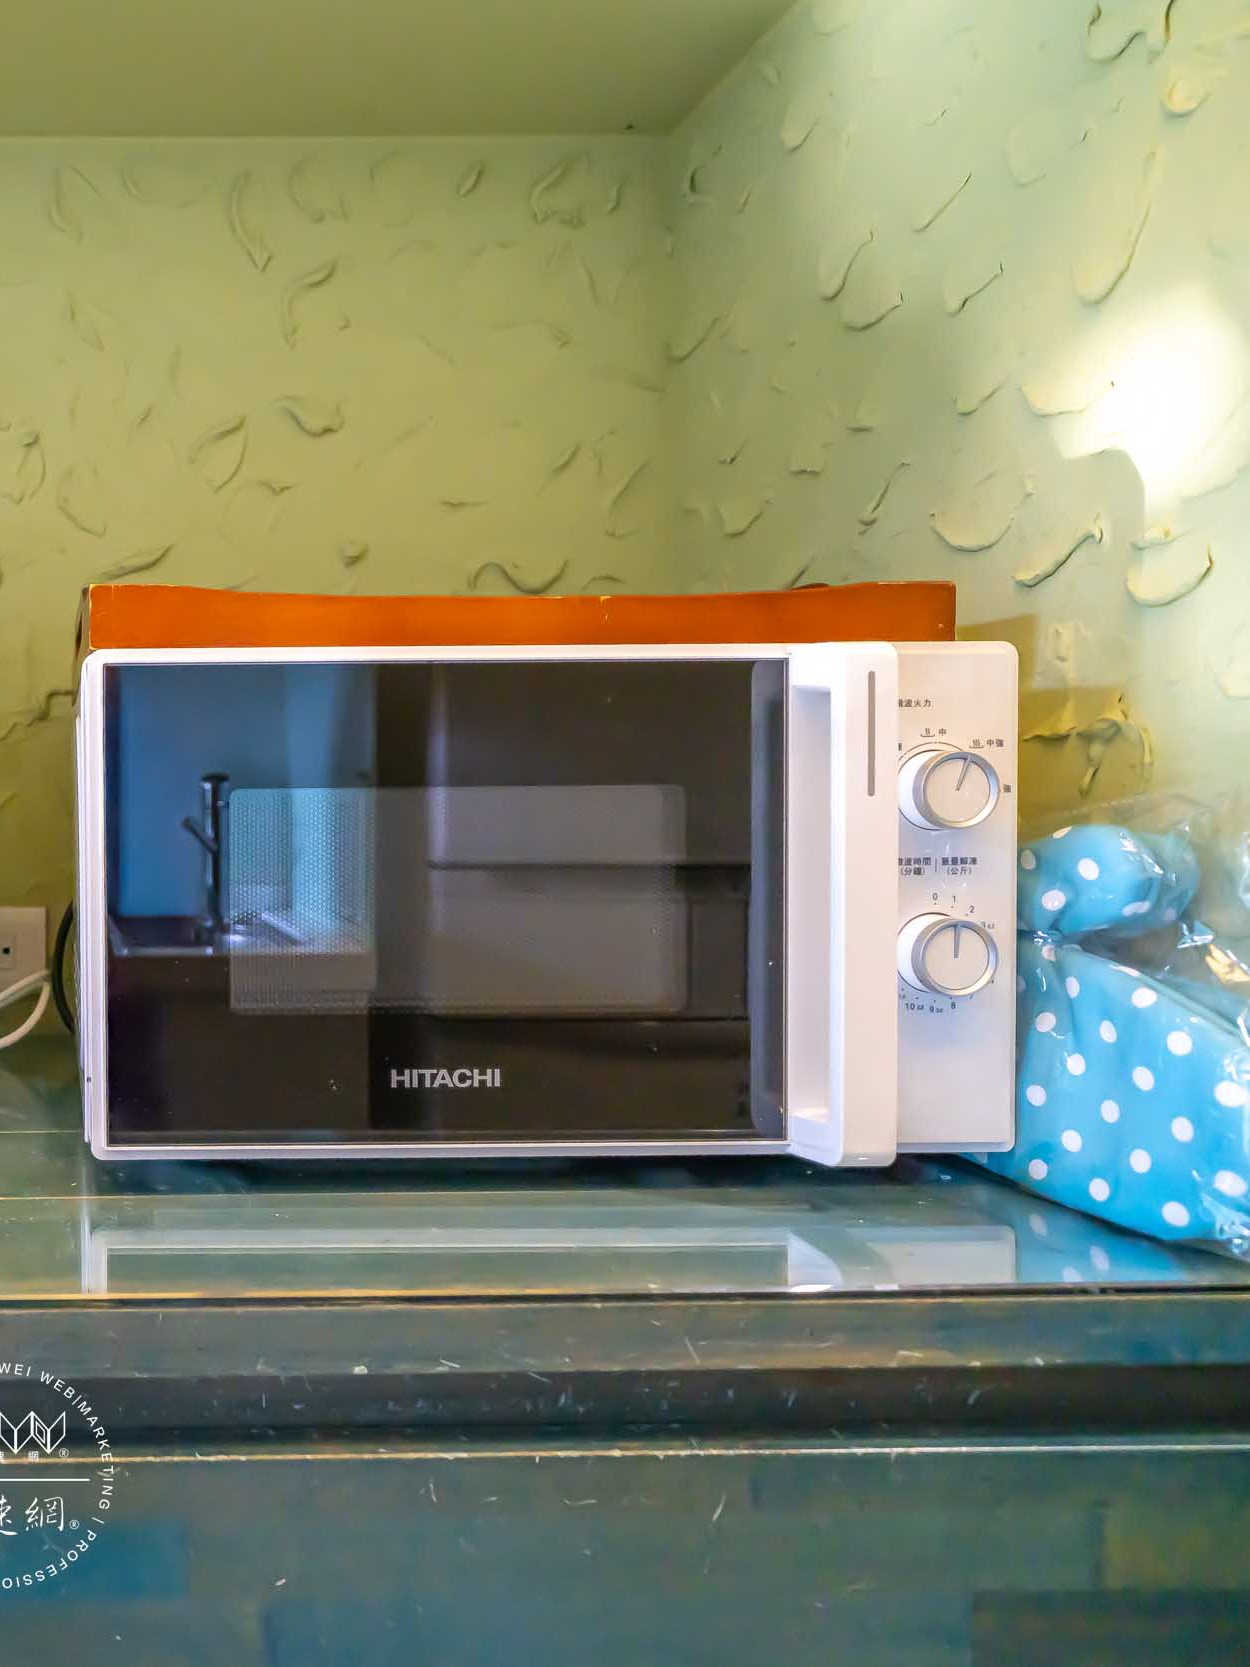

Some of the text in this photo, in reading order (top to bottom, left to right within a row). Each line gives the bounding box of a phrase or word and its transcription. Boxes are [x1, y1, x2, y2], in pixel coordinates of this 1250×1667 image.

[932, 892, 939, 901] 0
[969, 905, 975, 913] 2
[390, 1068, 501, 1088] HITACHI
